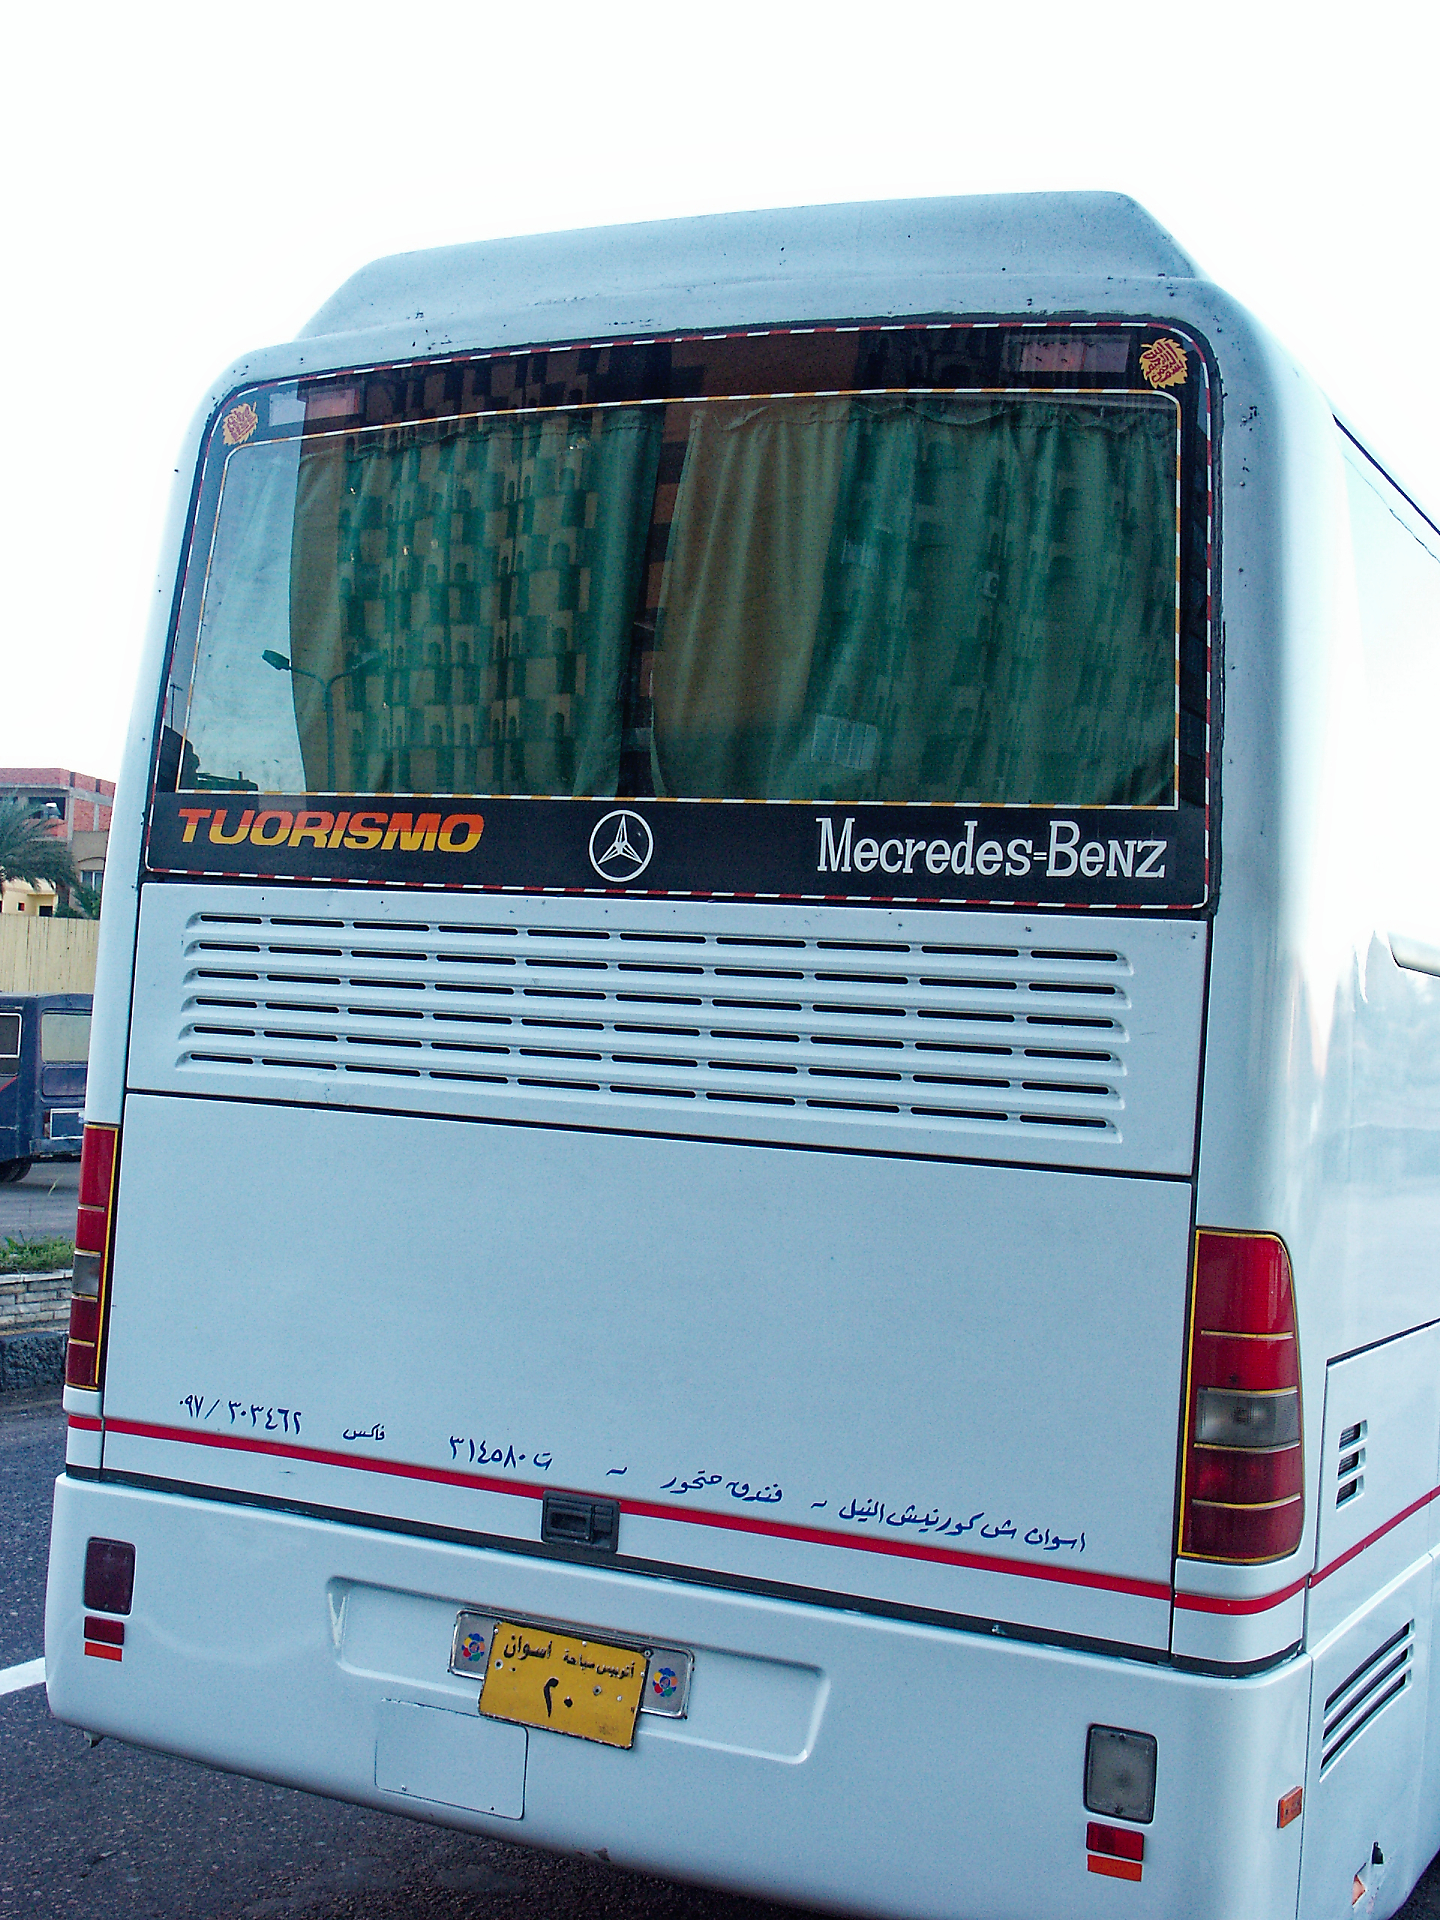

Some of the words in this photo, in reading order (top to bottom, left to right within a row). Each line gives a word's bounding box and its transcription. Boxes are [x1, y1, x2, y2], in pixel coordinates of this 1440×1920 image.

[178, 808, 485, 853] TUORISMO
[342, 1422, 386, 1441] فاكس
[449, 1435, 527, 1469] ٣١٤٥٨٠
[725, 1481, 783, 1503] فندق
[838, 1498, 886, 1524] النيل
[885, 1504, 985, 1537] كورنيش
[543, 1677, 574, 1718] ٢٠
